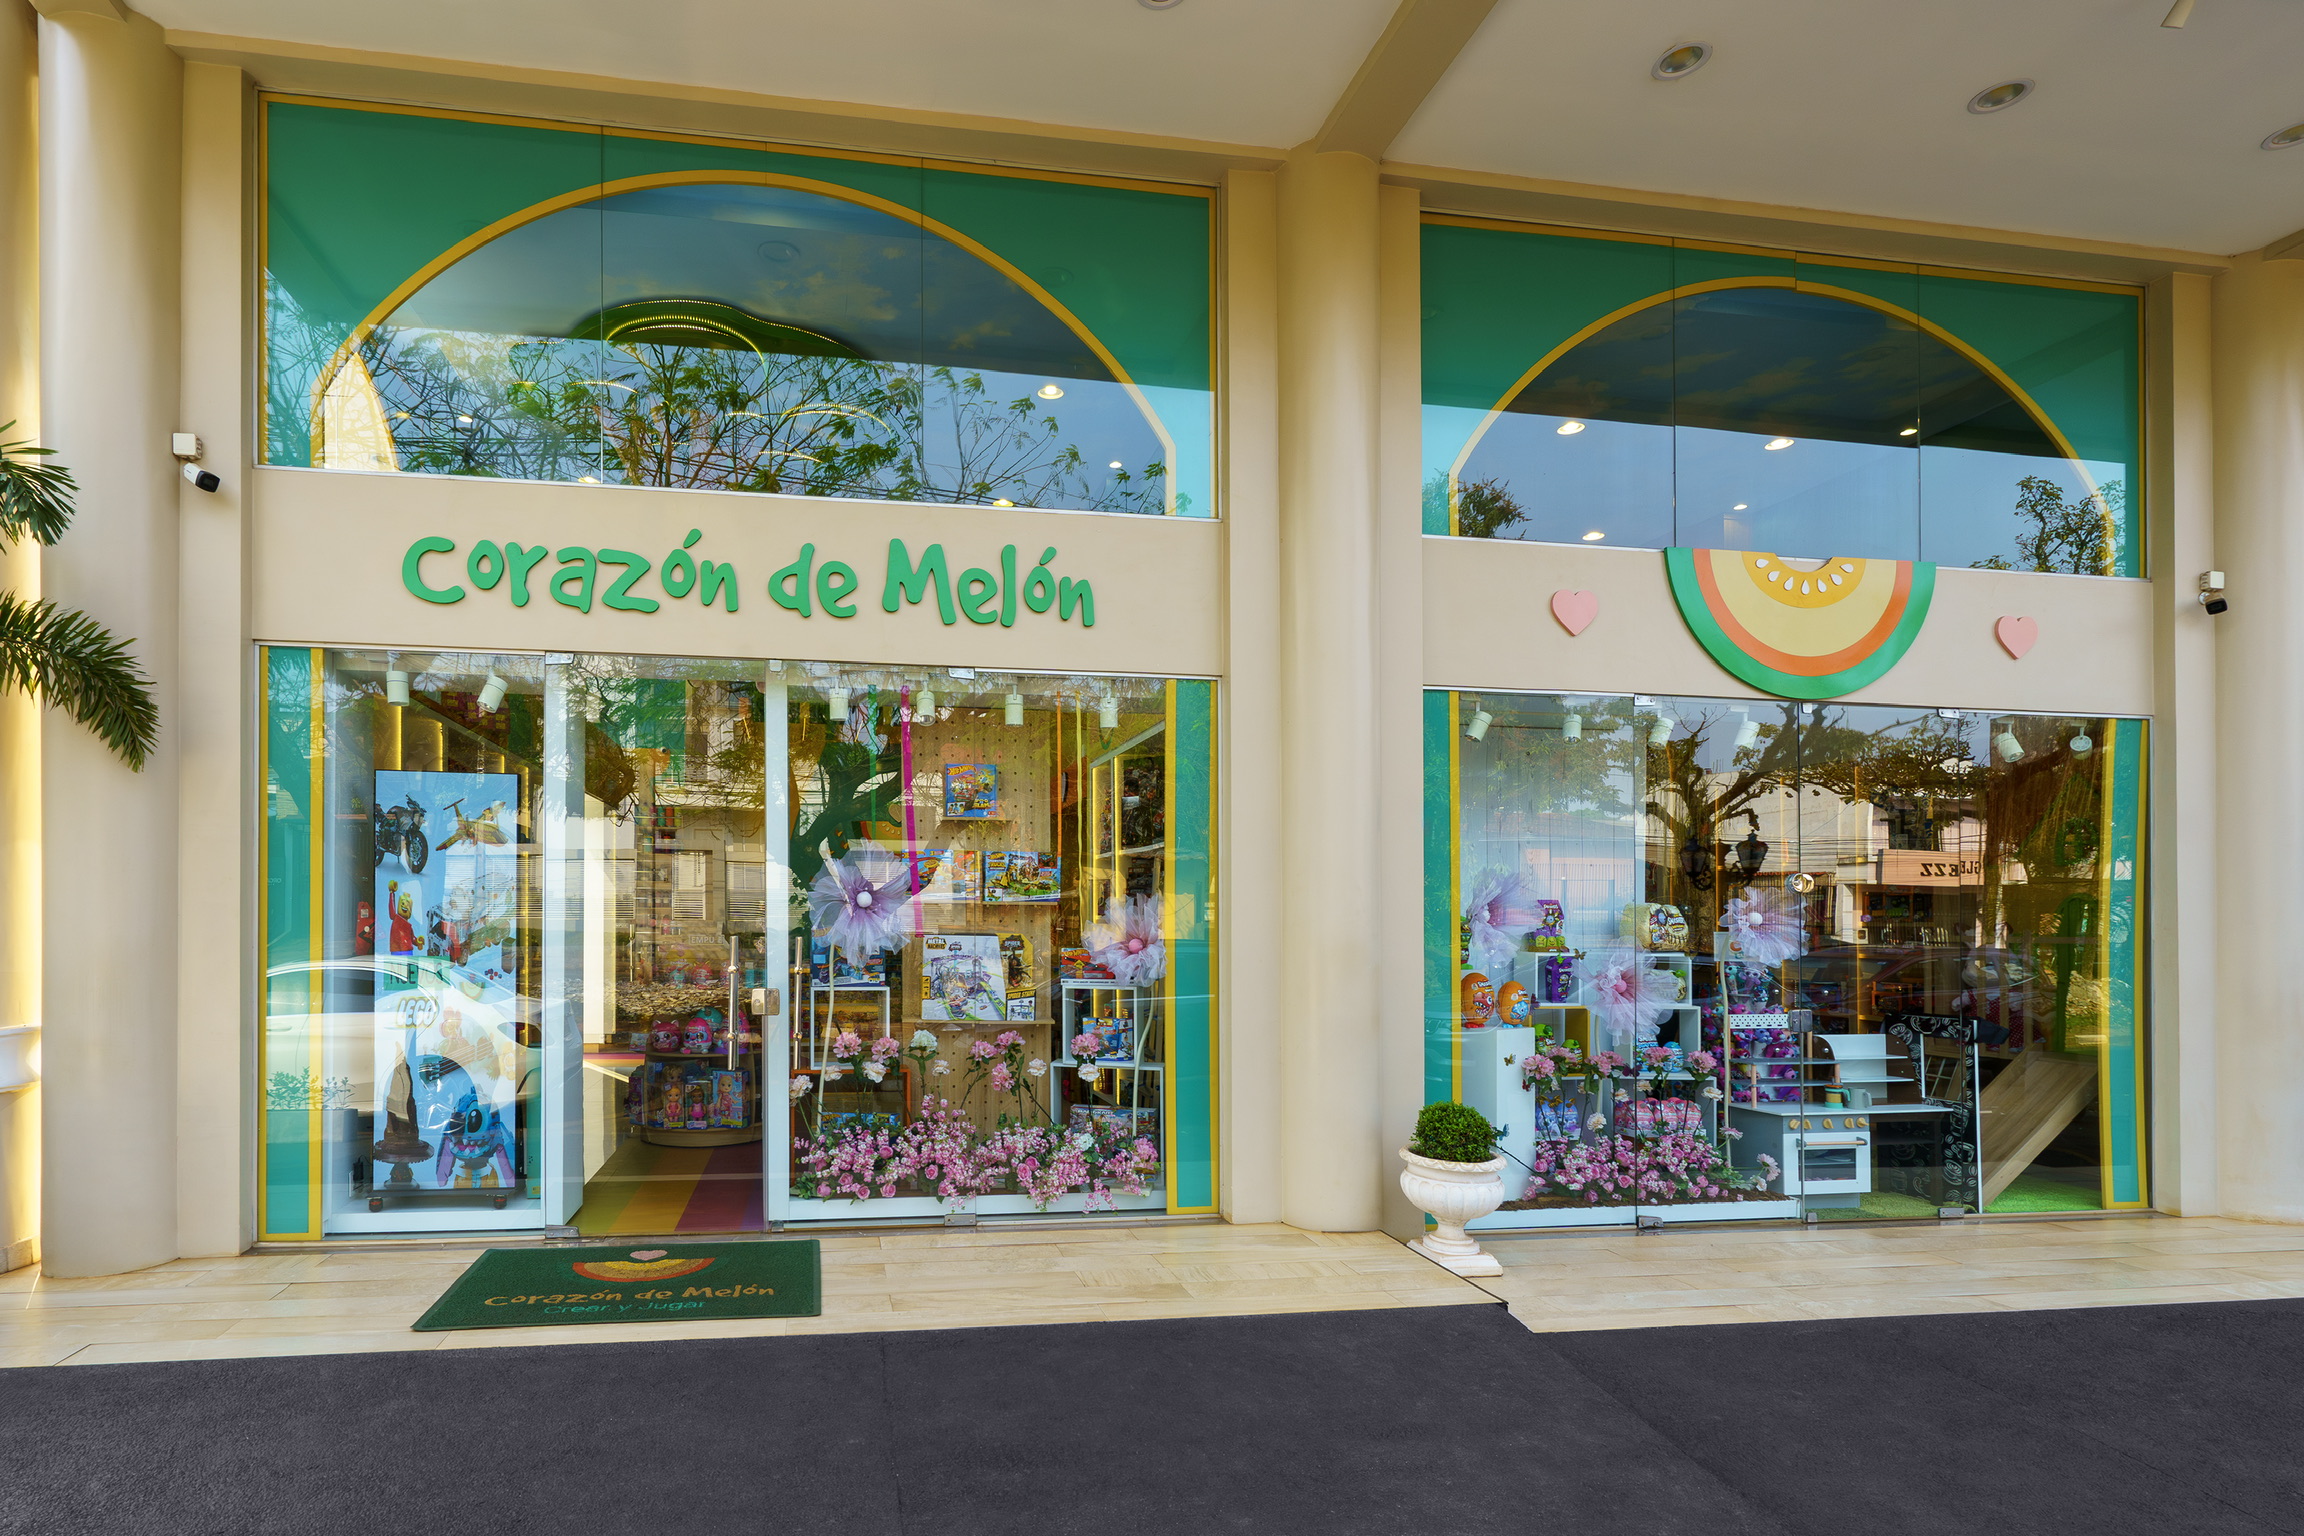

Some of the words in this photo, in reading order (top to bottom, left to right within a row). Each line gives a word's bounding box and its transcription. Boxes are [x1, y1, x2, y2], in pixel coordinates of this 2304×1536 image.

[402, 528, 738, 615] Corazón
[768, 542, 858, 618] de
[881, 537, 1096, 628] Melón
[691, 936, 723, 944] EMPUE
[395, 998, 437, 1027] LEGO
[484, 1289, 622, 1307] Corazón
[635, 1288, 673, 1300] de
[682, 1283, 776, 1298] Melón
[618, 1302, 633, 1312] y
[638, 1298, 707, 1313] Jugar
